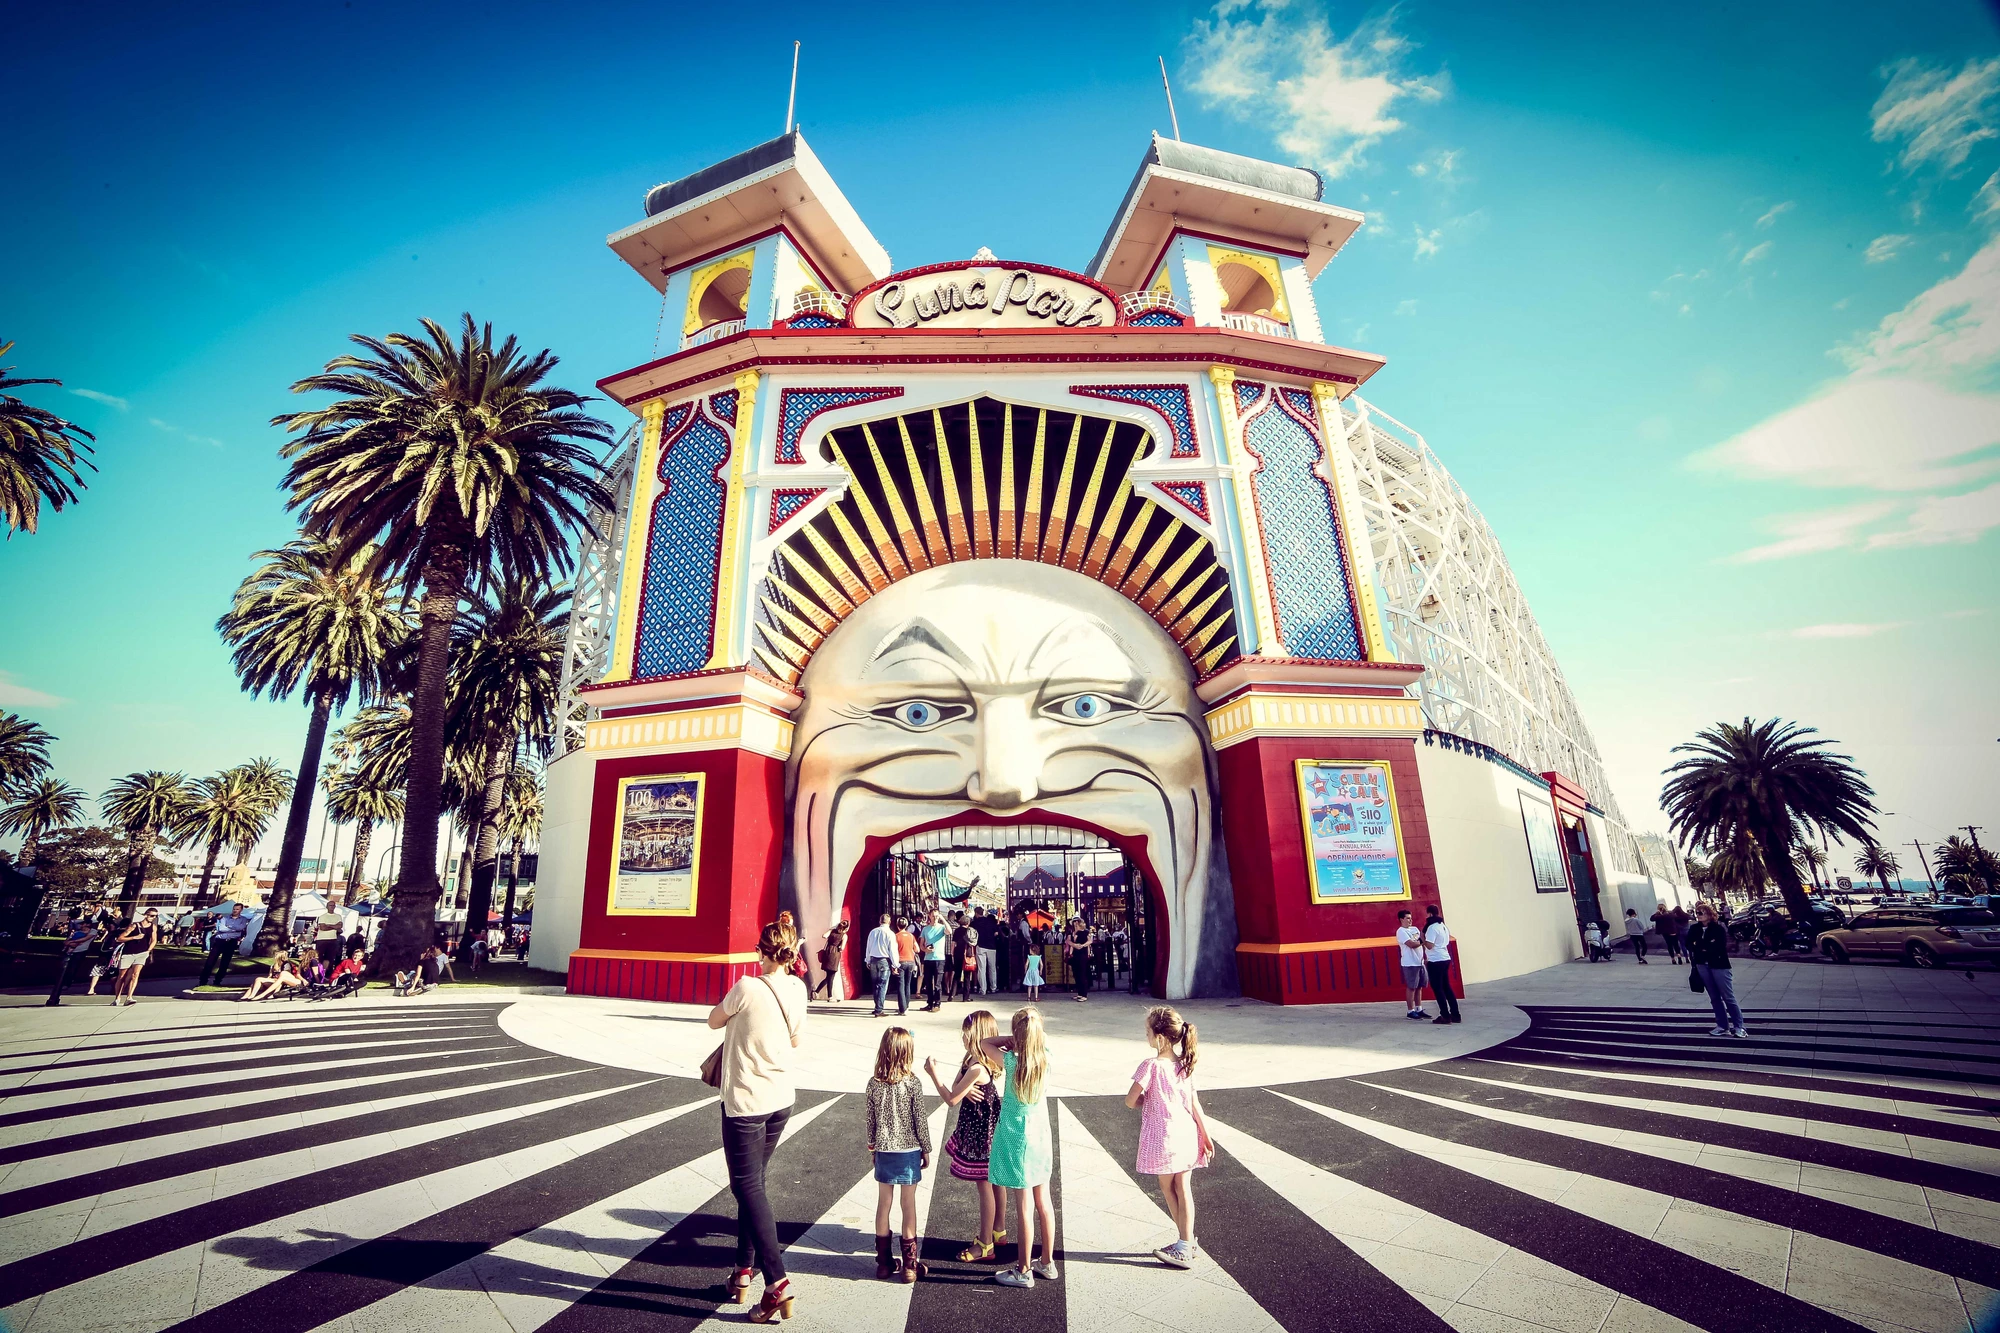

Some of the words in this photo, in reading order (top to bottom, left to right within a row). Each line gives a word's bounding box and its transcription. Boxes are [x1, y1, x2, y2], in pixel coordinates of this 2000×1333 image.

[874, 279, 989, 328] Luna
[992, 269, 1103, 326] Park
[628, 790, 652, 807] 100
[1363, 826, 1384, 835] FUN!
[1327, 854, 1359, 862] OPENING
